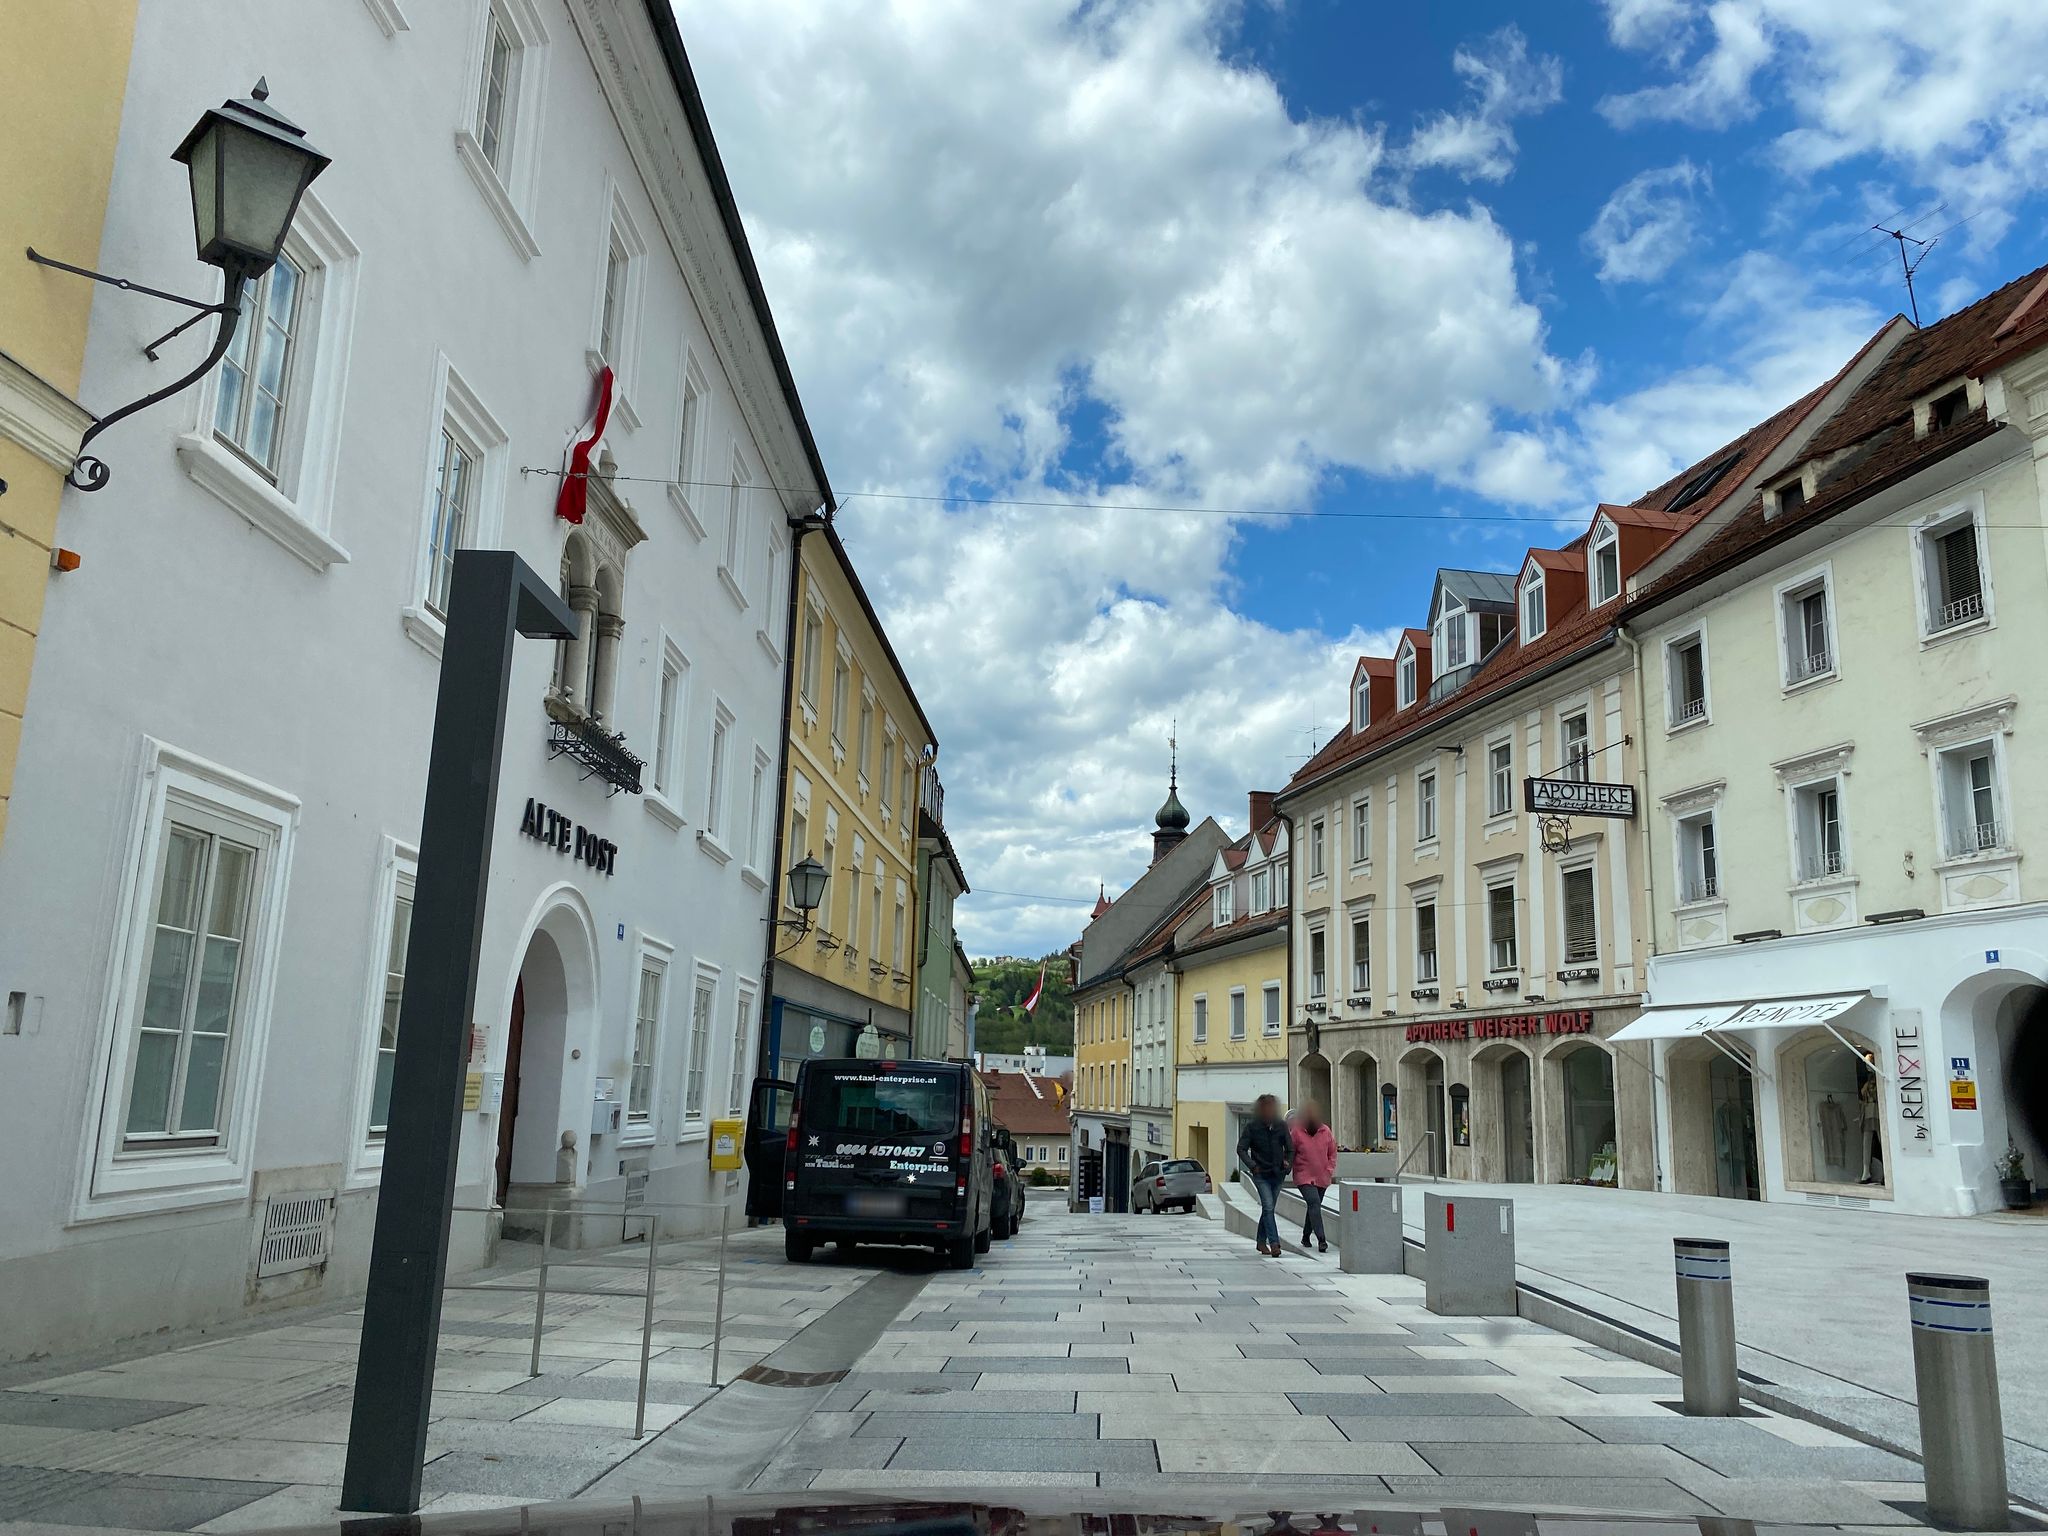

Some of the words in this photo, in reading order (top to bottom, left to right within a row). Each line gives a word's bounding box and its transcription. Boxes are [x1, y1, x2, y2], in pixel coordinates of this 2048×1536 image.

[1538, 782, 1630, 804] APOTHEKE
[1545, 797, 1632, 813] Drogerie
[520, 797, 572, 853] ALTE
[574, 825, 618, 876] POST
[1405, 1021, 1467, 1042] APOTHEKE
[1473, 1015, 1538, 1038] WEISSER
[1544, 1010, 1592, 1034] WOLF
[1955, 1059, 1966, 1067] 11
[834, 1074, 937, 1085] www.taxi-enterprise.at
[869, 1145, 926, 1157] 4570457
[815, 1158, 839, 1168] Taxi
[889, 1160, 949, 1173] Enterprise
